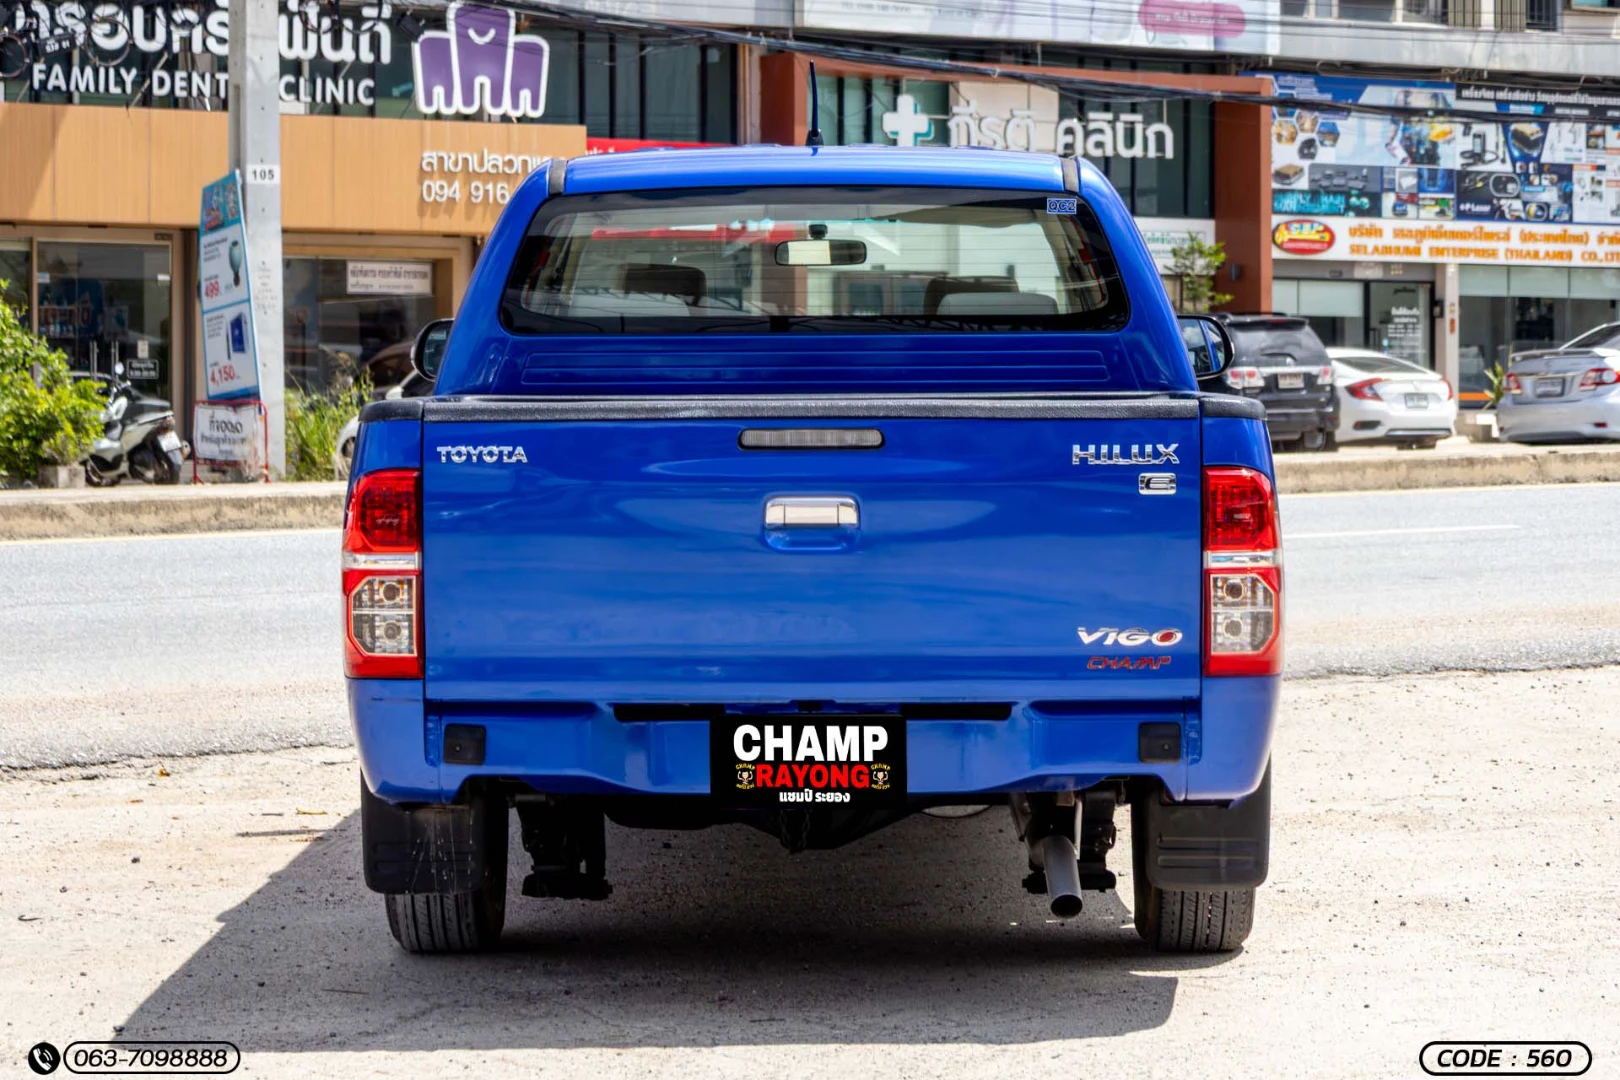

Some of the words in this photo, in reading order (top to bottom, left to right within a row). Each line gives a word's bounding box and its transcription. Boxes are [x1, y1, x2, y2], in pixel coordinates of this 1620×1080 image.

[33, 63, 137, 95] FAMILY
[152, 70, 229, 99] DENT
[279, 74, 375, 106] CLINIC
[252, 169, 275, 181] 105
[422, 180, 460, 203] 094
[470, 181, 511, 205] 916
[437, 446, 528, 463] TOYOTA
[1072, 443, 1180, 465] HILUX
[1077, 627, 1183, 646] VIGO
[1087, 656, 1172, 669] CHAMP
